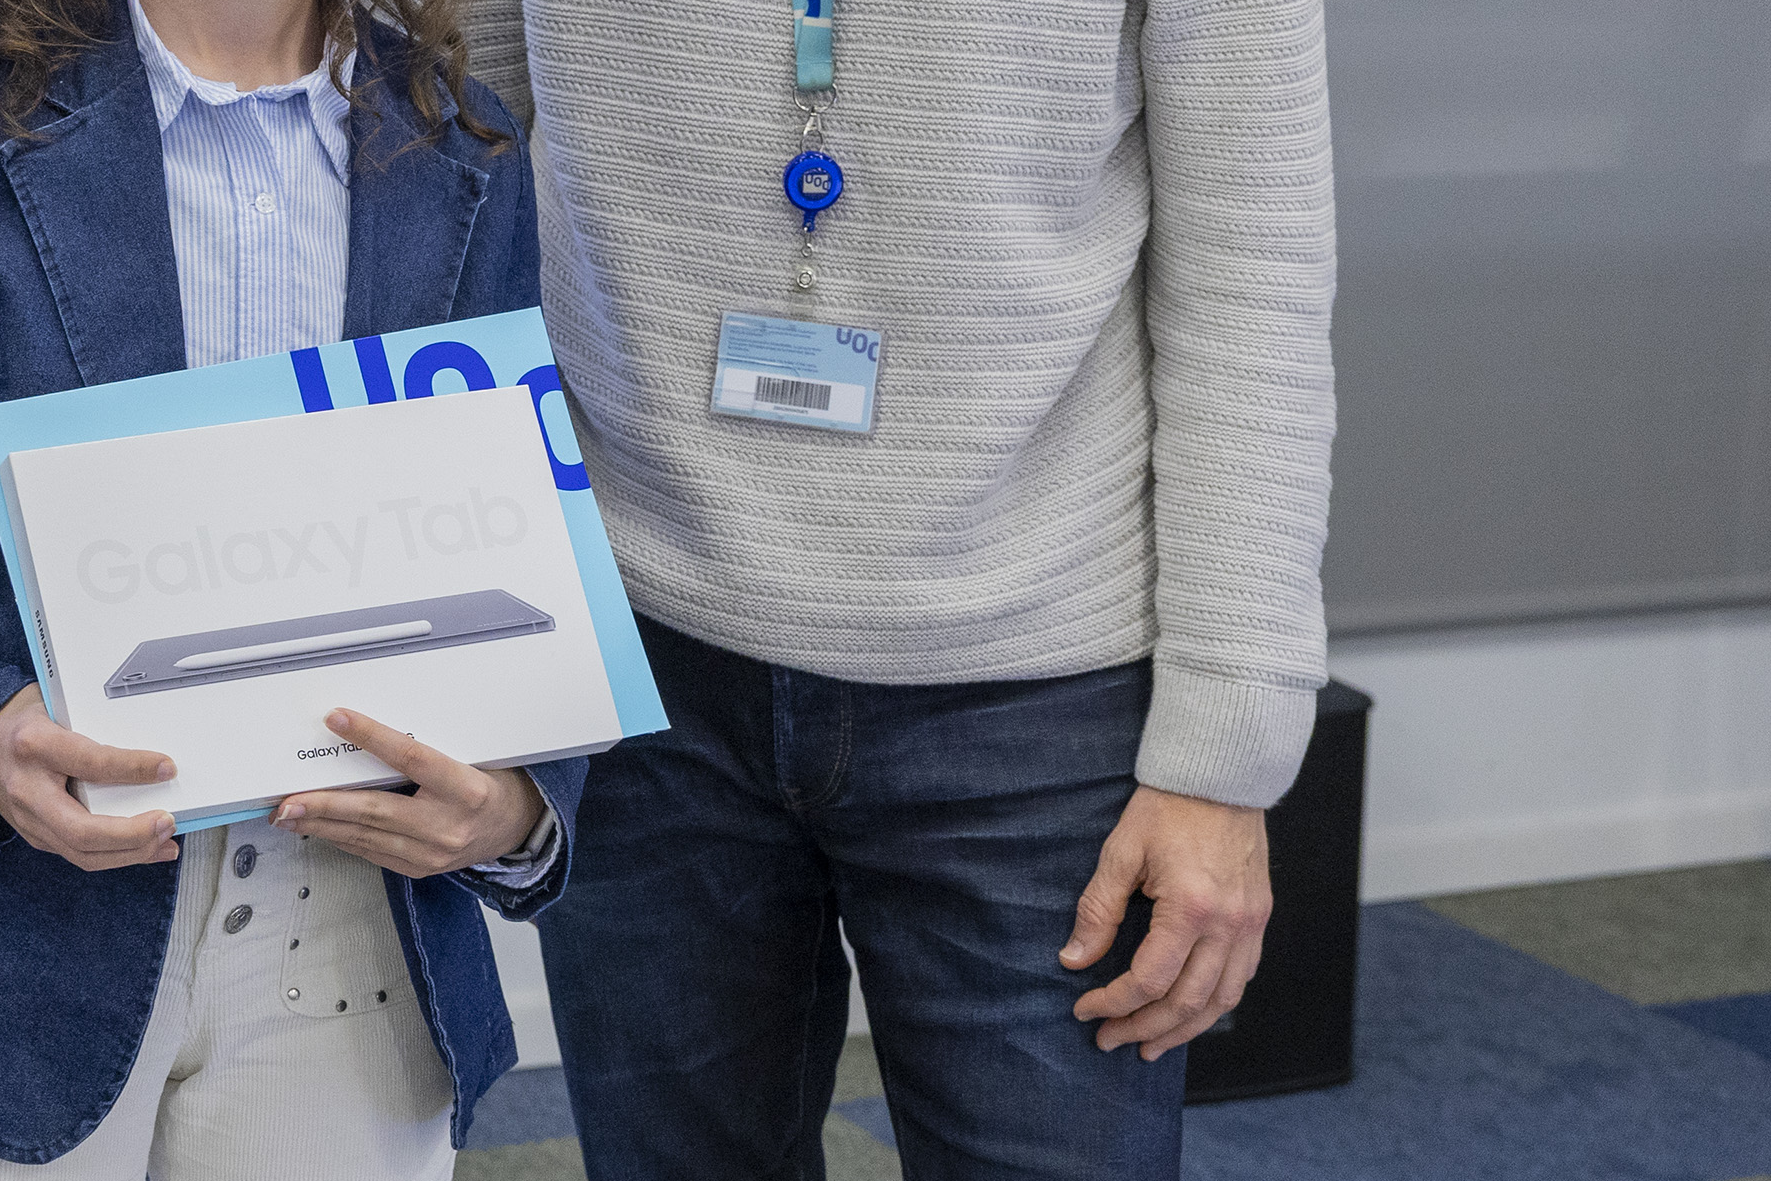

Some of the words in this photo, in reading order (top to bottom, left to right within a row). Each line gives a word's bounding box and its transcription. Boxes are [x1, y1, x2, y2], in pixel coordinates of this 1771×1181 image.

[836, 327, 879, 362] UOC
[76, 516, 368, 605] Galaxy
[376, 487, 529, 562] Tab
[35, 609, 54, 678] SAMSUNG
[296, 745, 340, 761] Galaxy
